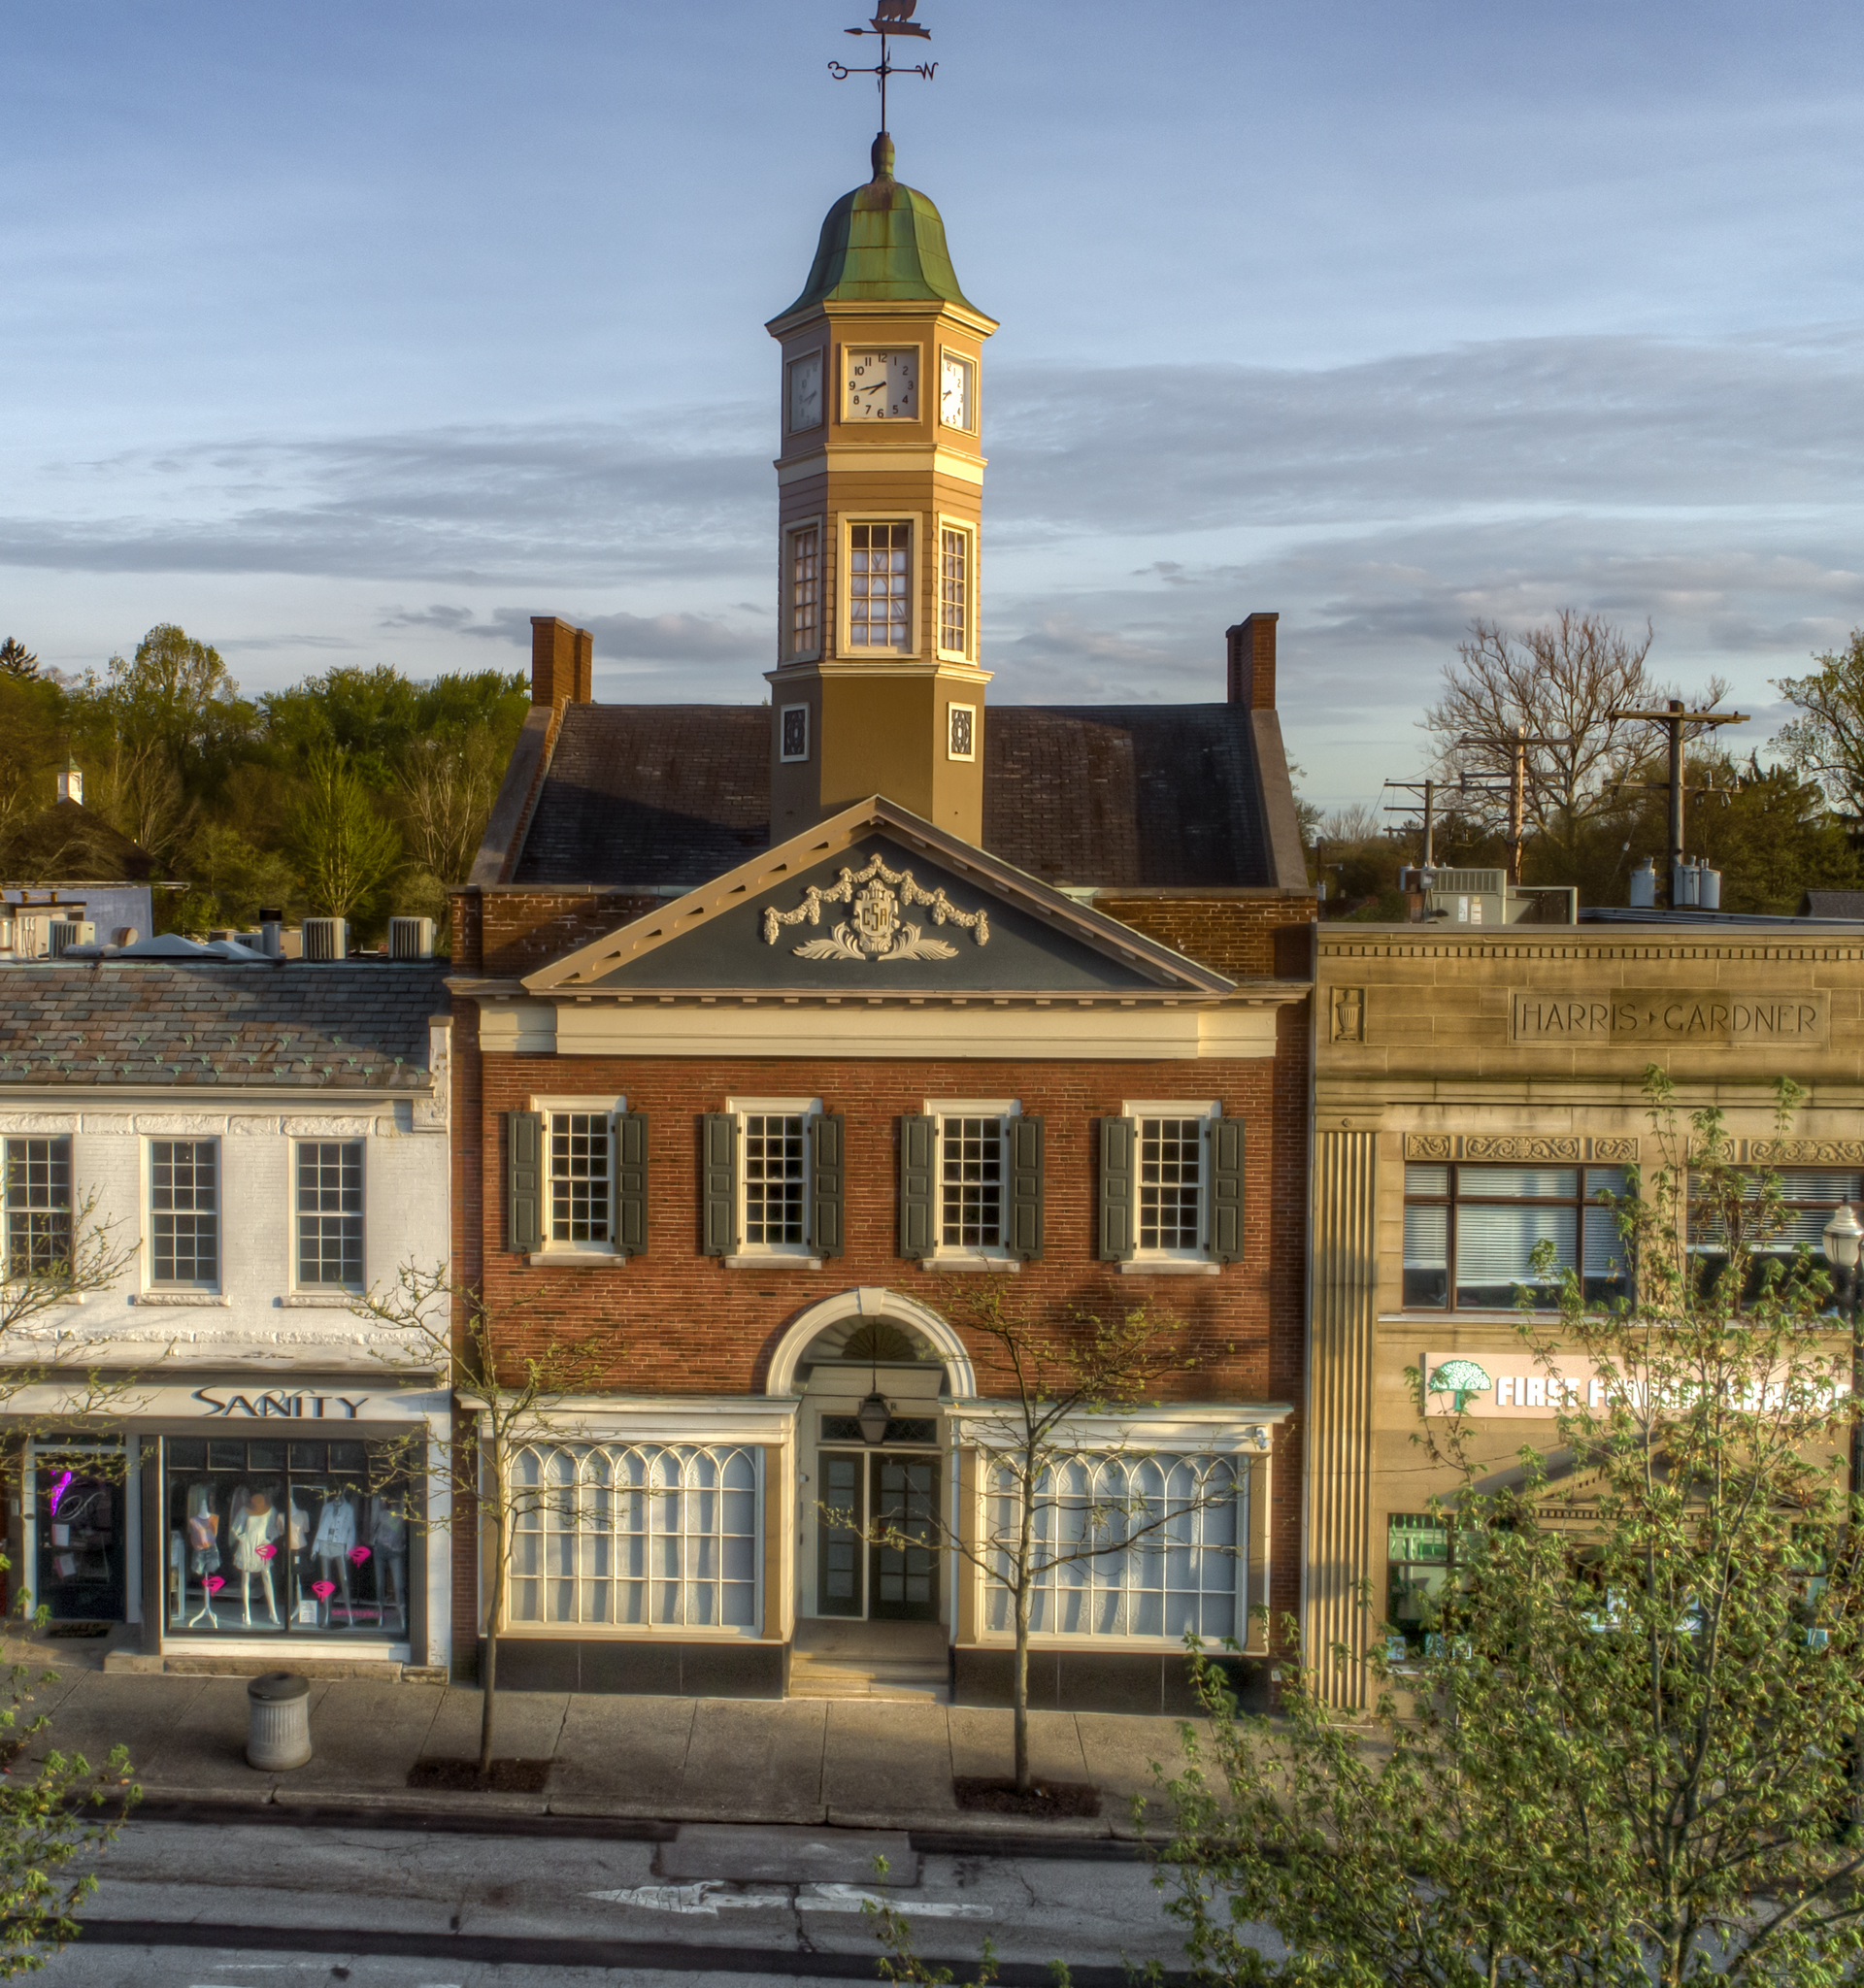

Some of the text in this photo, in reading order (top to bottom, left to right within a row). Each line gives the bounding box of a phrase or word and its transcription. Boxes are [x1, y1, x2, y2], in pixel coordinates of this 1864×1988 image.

[865, 356, 872, 367] 11
[878, 353, 887, 363] 12
[893, 356, 897, 366] 1
[854, 366, 865, 376] 10
[902, 366, 909, 376] 2
[849, 381, 856, 390] 9
[908, 381, 915, 390] 3
[852, 395, 860, 405] 8
[902, 394, 909, 404] 4
[865, 405, 872, 414] 7
[877, 409, 884, 418] 6
[892, 405, 899, 414] 5
[863, 902, 887, 932] CSA
[1521, 1003, 1817, 1033] HARRIS GARDNER
[1496, 1376, 1581, 1408] FIRST
[190, 1385, 370, 1419] SANITY
